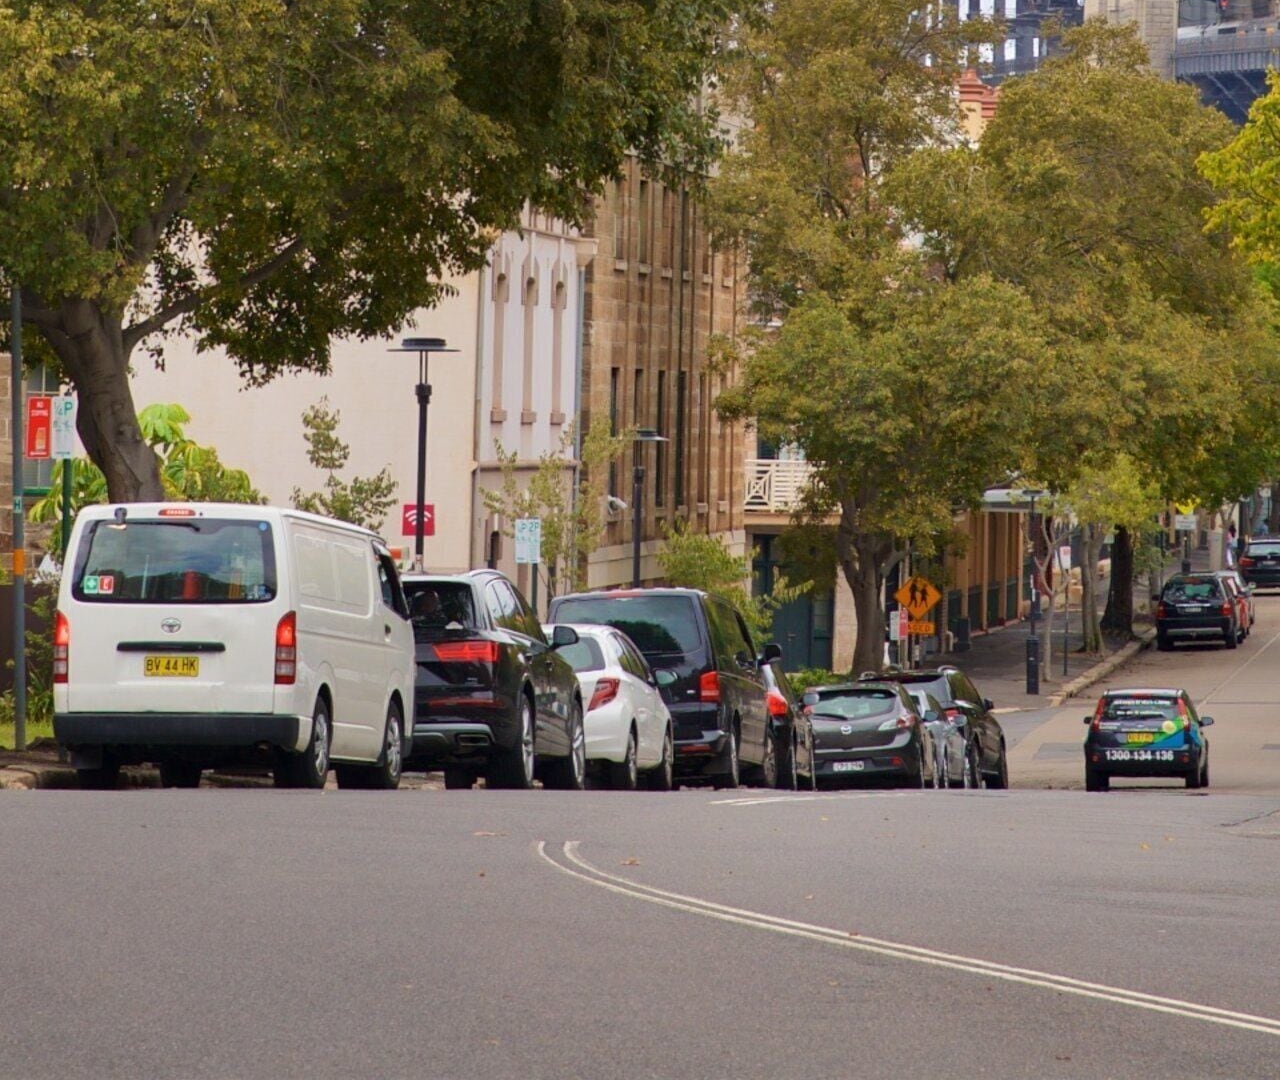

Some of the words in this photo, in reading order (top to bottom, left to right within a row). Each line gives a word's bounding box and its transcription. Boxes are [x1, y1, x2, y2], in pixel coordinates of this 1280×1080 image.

[1105, 750, 1130, 761] 1300
[1133, 750, 1152, 761] 134
[1155, 750, 1174, 761] 136
